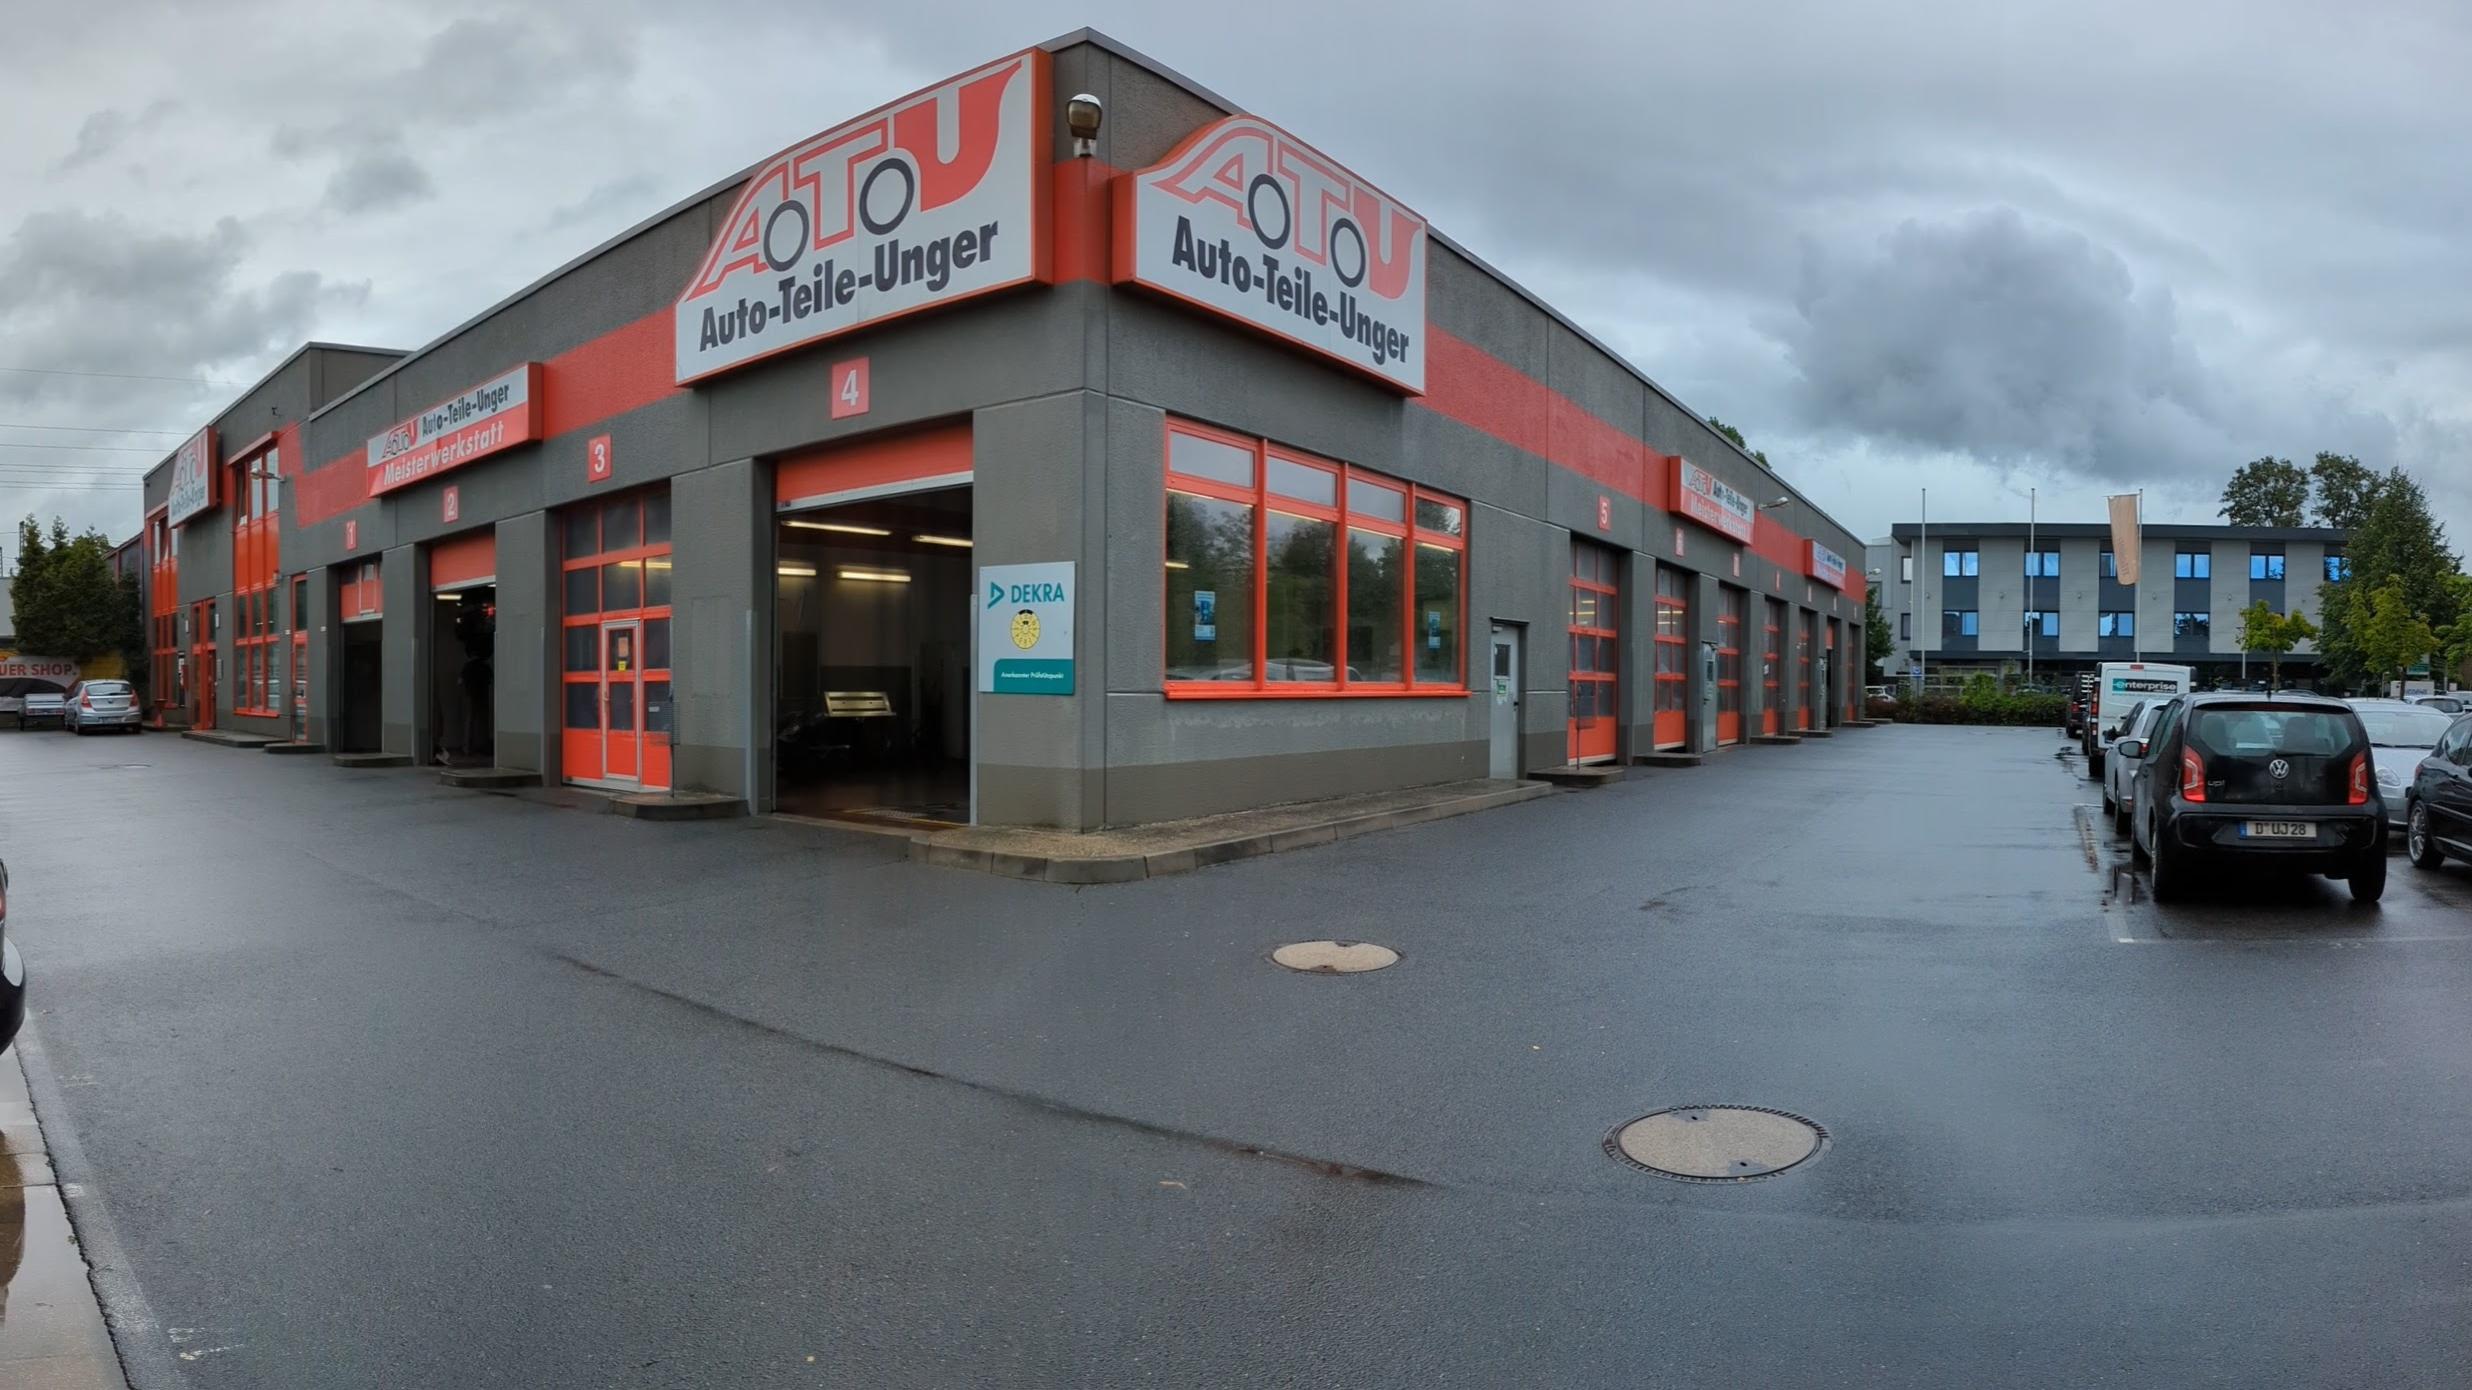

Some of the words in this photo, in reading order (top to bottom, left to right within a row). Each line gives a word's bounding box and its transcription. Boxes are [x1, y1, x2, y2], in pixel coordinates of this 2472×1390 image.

[699, 220, 999, 352] Auto-Teile-Unger
[1172, 215, 1410, 366] Auto-Teile-Unger
[840, 369, 860, 406] 4
[422, 384, 510, 437] Auto-Teile-Unger
[383, 420, 505, 486] Meisterwerkstatt
[594, 443, 605, 473] 3
[447, 492, 455, 517] 2
[1600, 501, 1608, 525] 5
[1011, 582, 1065, 604] DEKRA
[31, 663, 77, 676] SHOP.
[2112, 681, 2177, 691] enterprise
[2255, 823, 2264, 835] D
